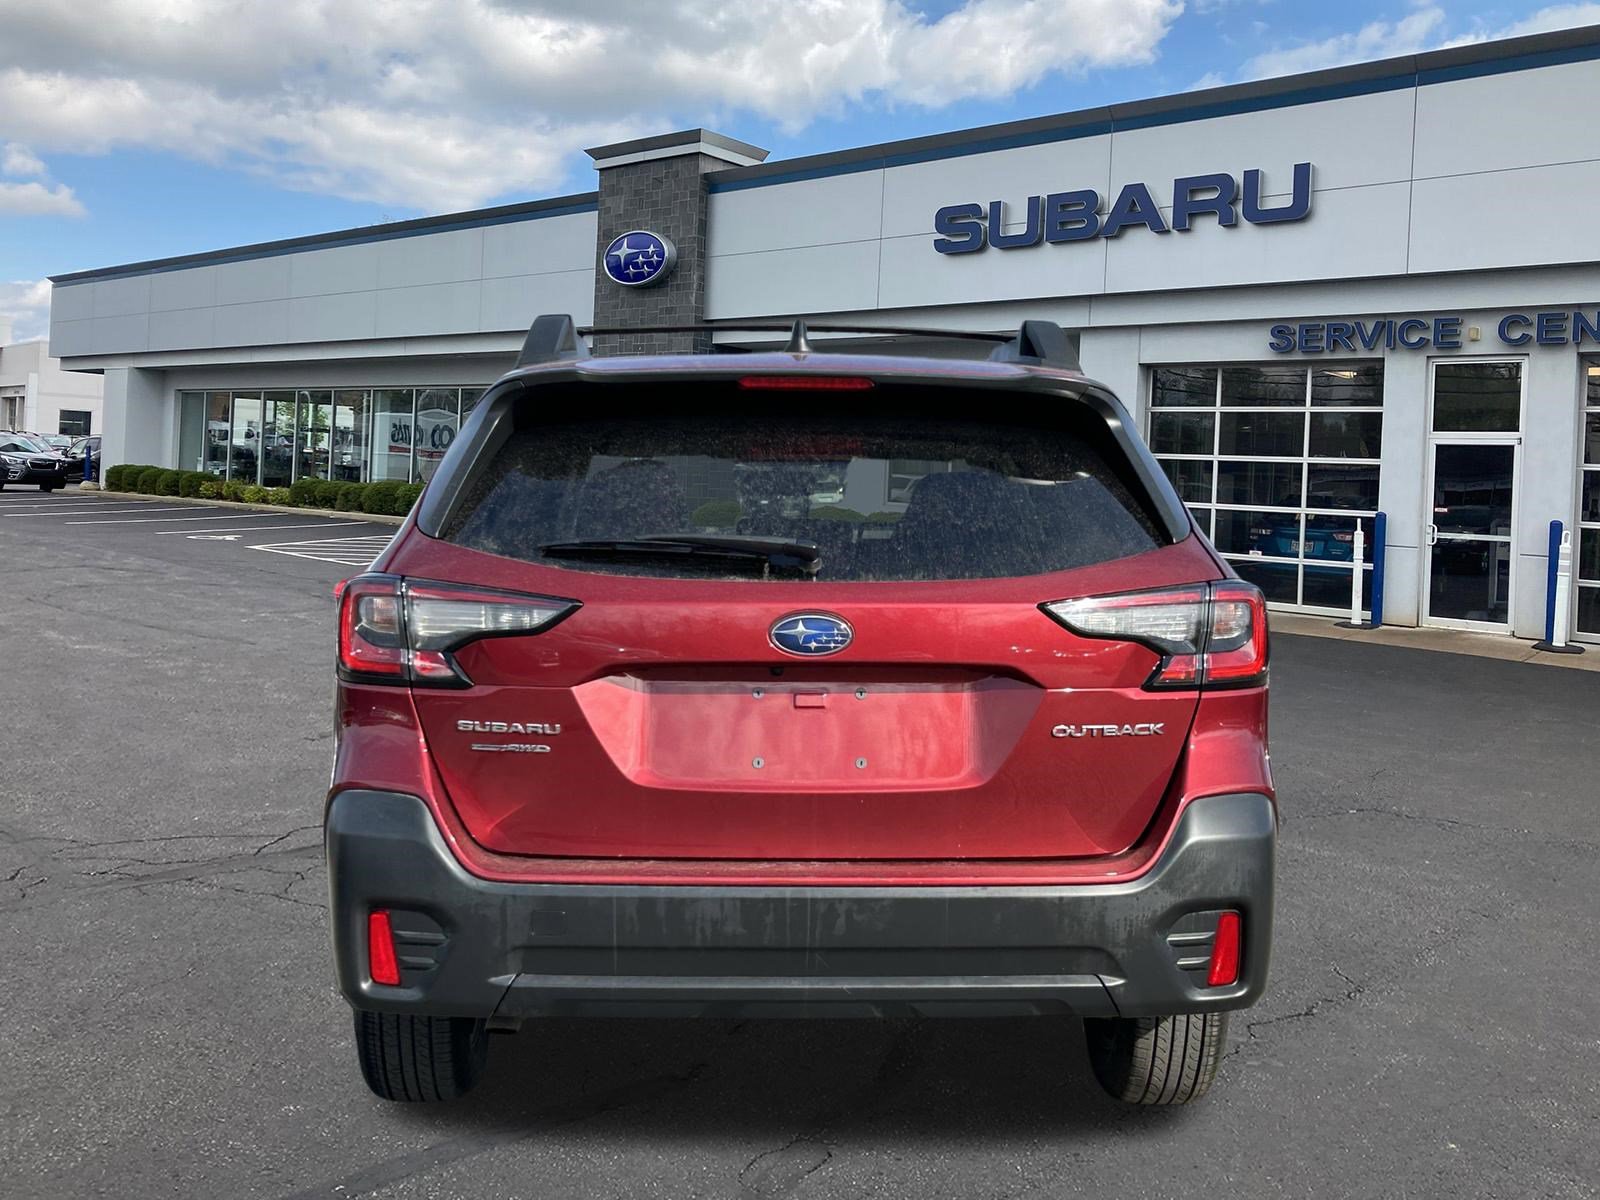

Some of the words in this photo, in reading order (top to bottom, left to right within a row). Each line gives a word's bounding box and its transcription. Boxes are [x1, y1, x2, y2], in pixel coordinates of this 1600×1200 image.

[933, 162, 1312, 254] SUBARU
[1269, 317, 1463, 352] SERVICE
[457, 719, 561, 735] SUBARU
[1052, 722, 1165, 738] OUTBACK
[506, 743, 552, 753] AWD
